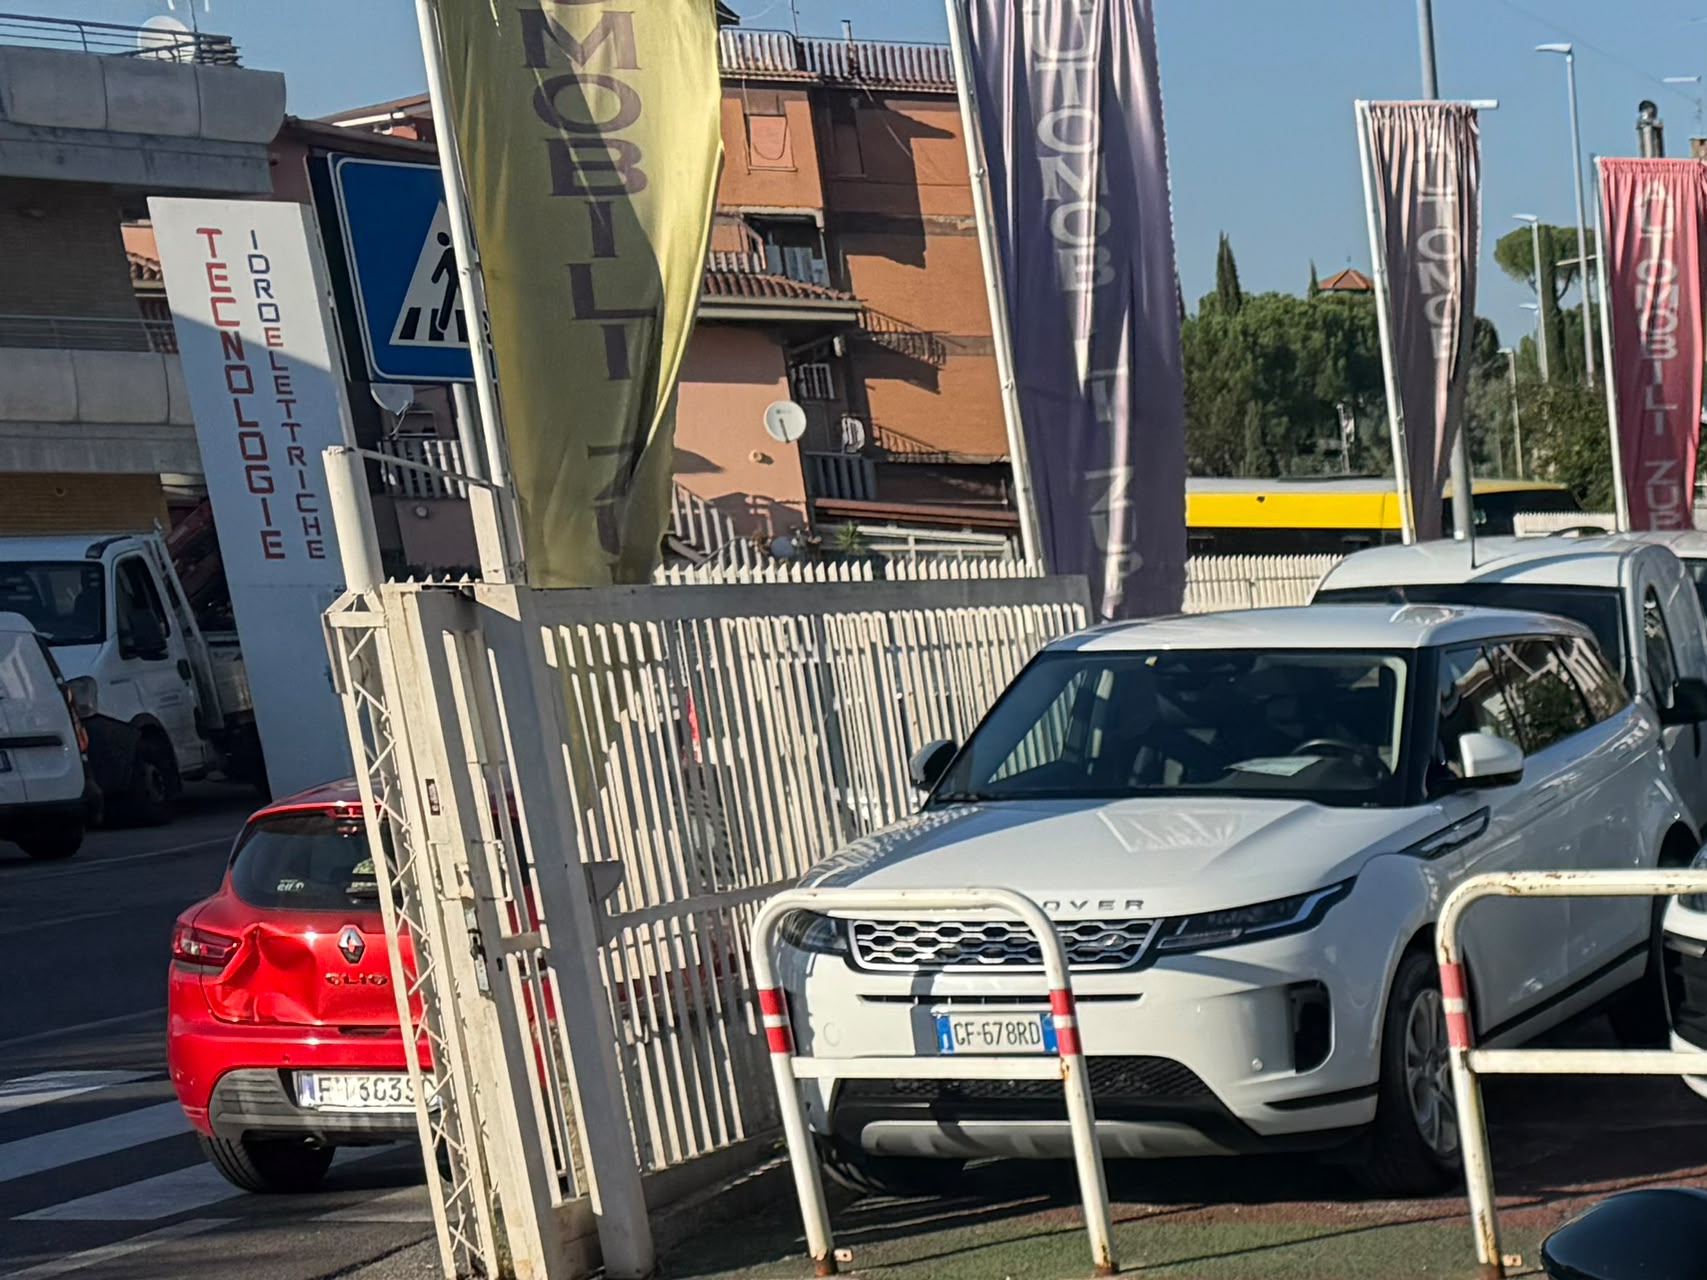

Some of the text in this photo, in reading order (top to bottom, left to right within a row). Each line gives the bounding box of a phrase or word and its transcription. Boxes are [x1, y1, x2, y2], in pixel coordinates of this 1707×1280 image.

[518, 0, 668, 381] MOBILI
[196, 227, 286, 560] TECNOLOGIE
[247, 229, 326, 560] IDROELETTRICHE
[982, 1021, 1041, 1046] 678RD
[1043, 899, 1145, 912] OVER
